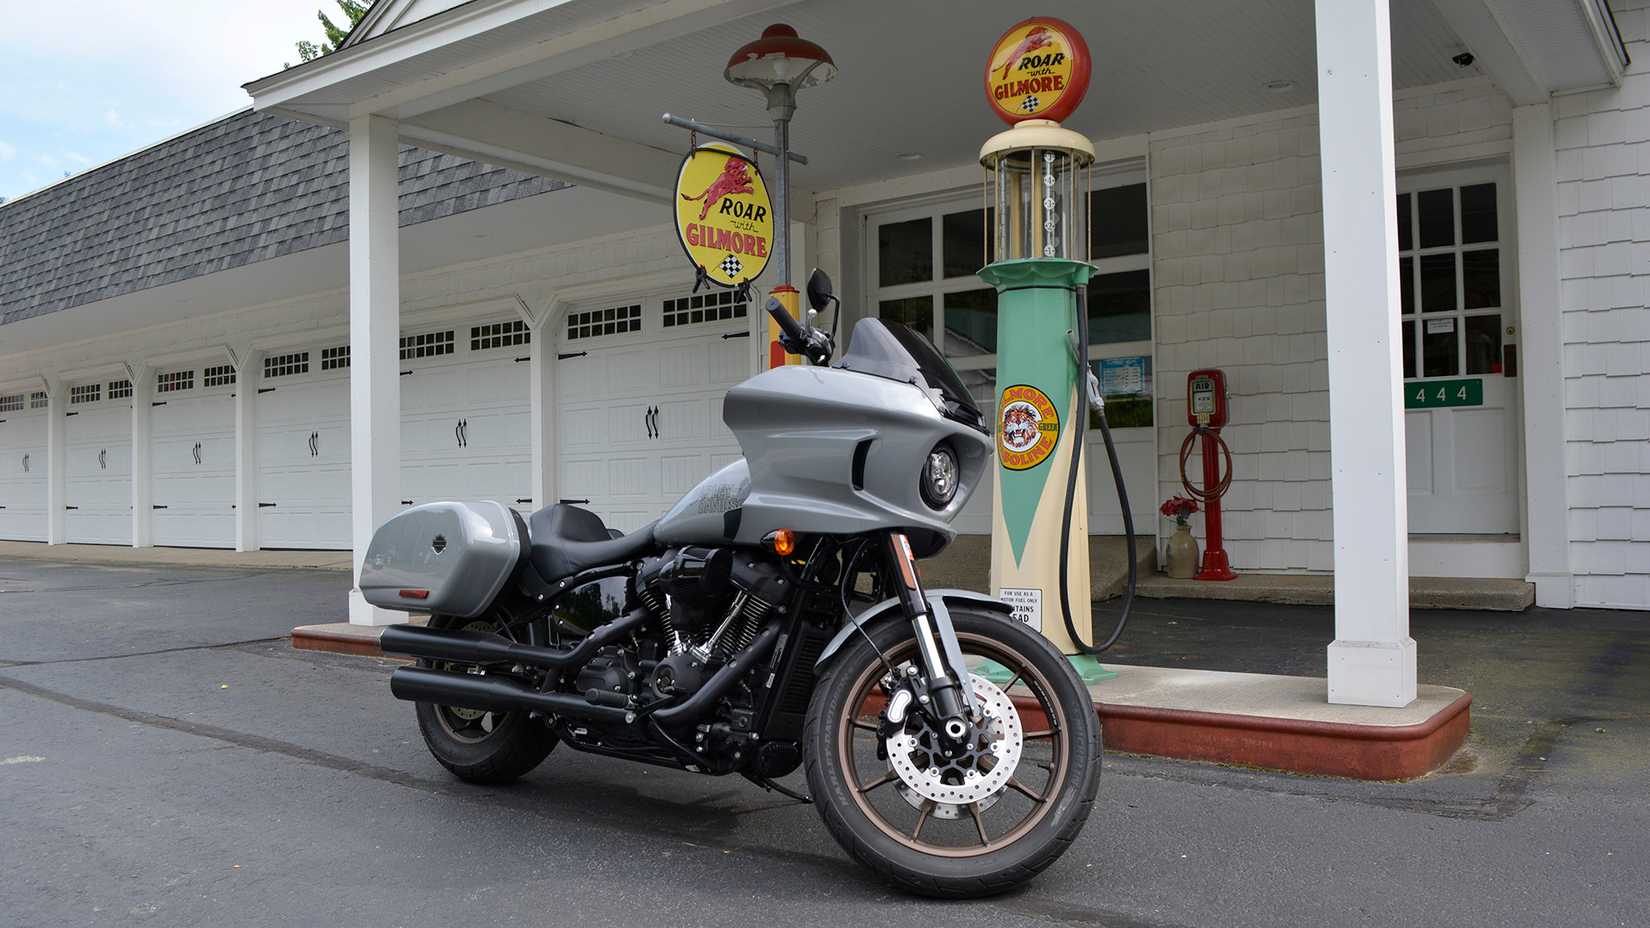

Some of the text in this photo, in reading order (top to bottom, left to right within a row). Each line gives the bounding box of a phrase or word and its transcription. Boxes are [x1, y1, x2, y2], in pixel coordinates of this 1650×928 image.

[1018, 53, 1065, 70] ROAR
[1028, 68, 1054, 77] with
[995, 75, 1064, 100] GILMORE
[720, 197, 766, 223] ROAR
[686, 223, 767, 257] GILMORE
[1195, 382, 1210, 390] AIR
[1012, 613, 1029, 623] EAD
